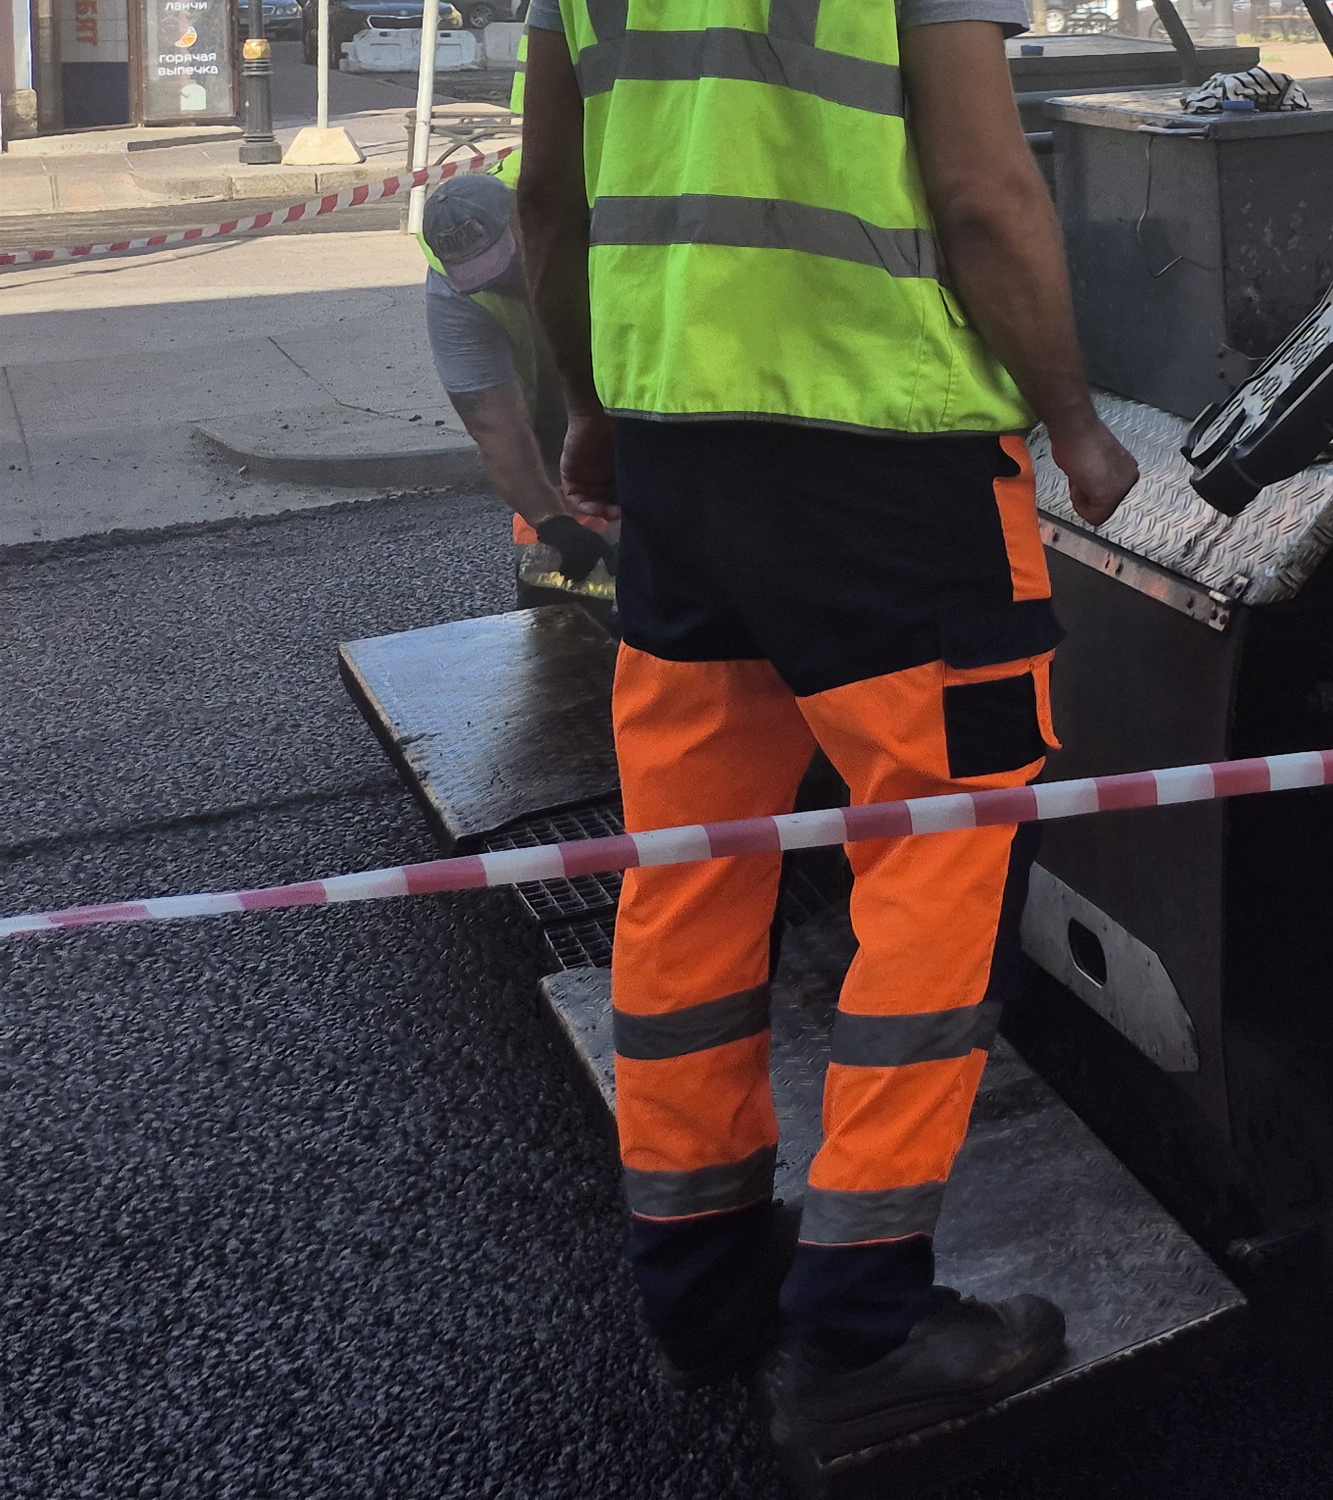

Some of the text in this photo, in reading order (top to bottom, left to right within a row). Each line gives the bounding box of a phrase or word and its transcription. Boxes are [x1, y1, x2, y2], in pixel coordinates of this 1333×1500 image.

[165, 1, 208, 11] ланчи
[159, 52, 217, 65] горячая
[158, 65, 219, 77] выпечка
